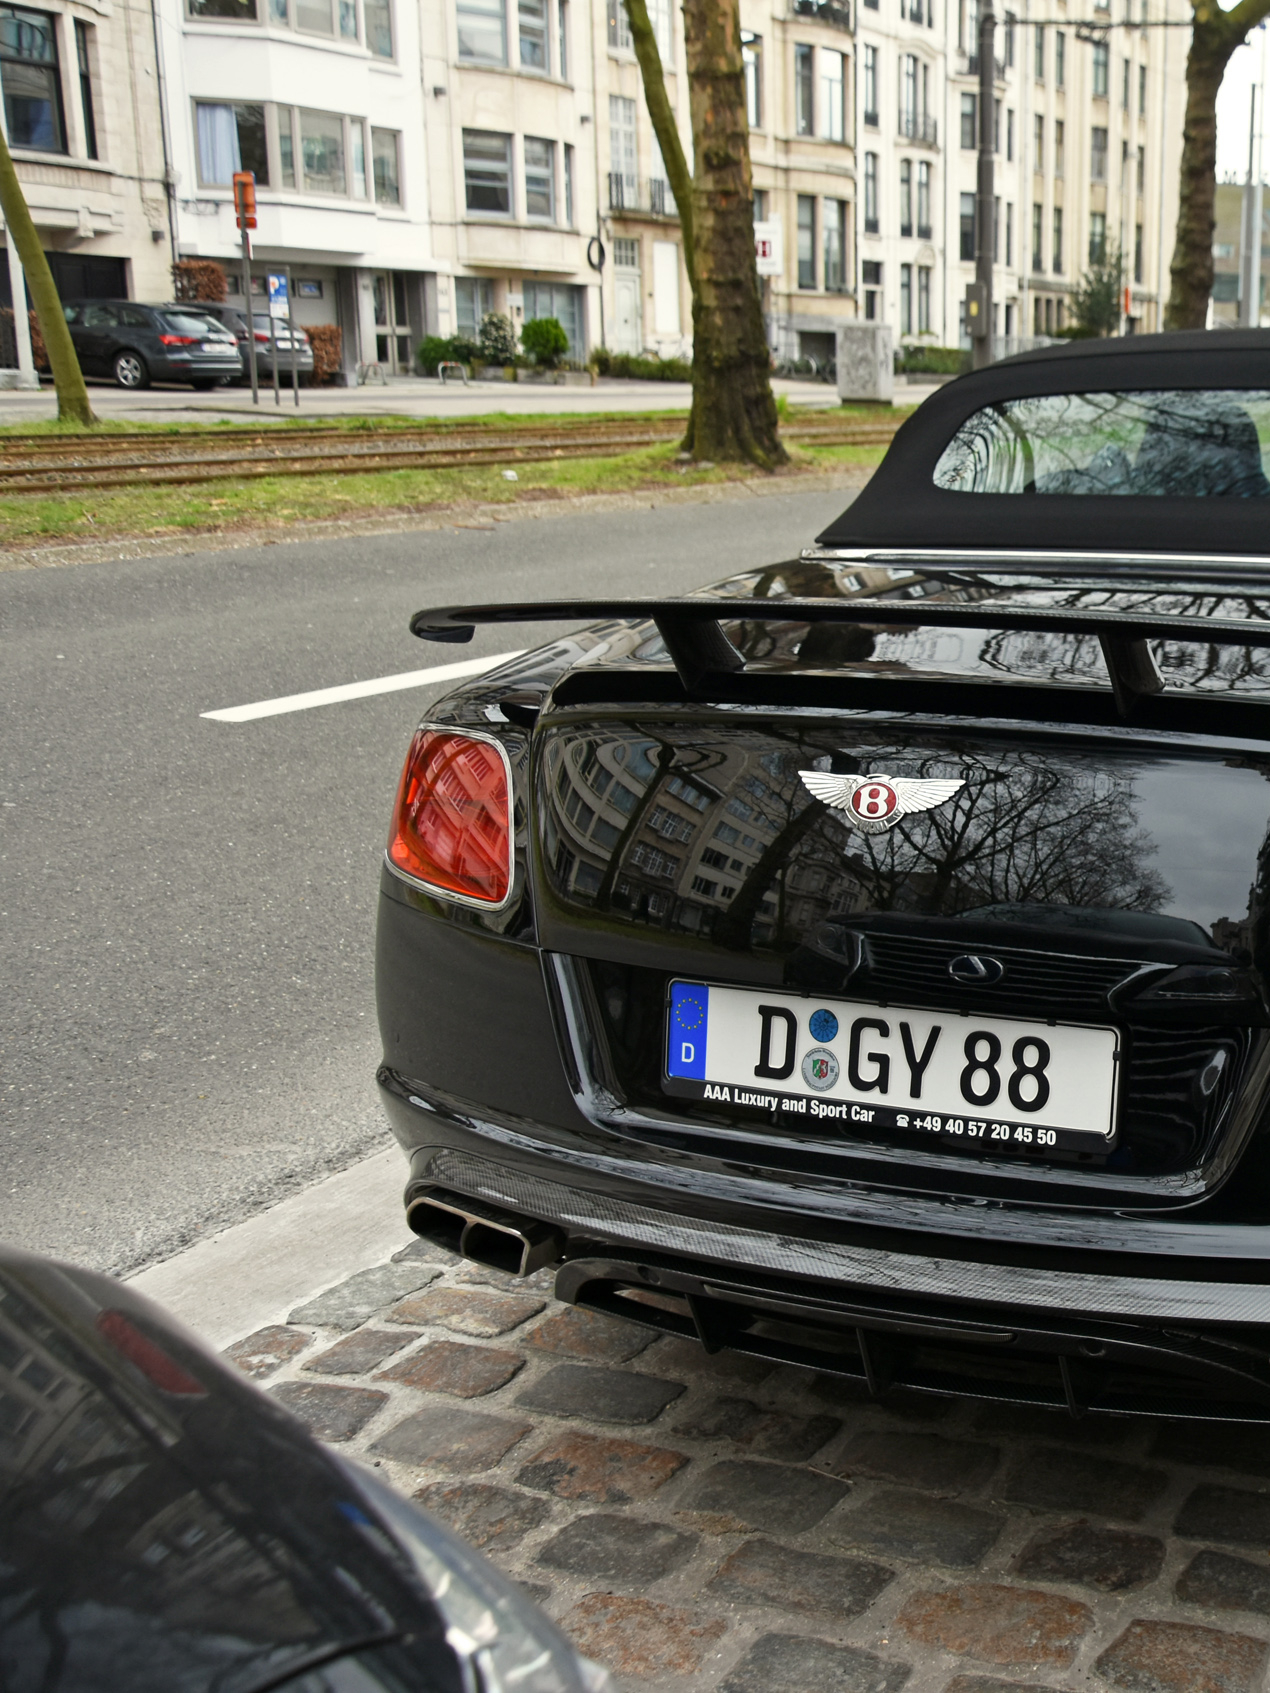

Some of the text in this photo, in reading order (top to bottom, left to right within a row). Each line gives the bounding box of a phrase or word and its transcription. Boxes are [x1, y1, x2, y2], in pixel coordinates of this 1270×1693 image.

[681, 1042, 695, 1063] D
[754, 1004, 1051, 1113] D GY 88
[703, 1084, 1057, 1146] AAA Luxury and Sport Car +49 40 57 20 45 50
